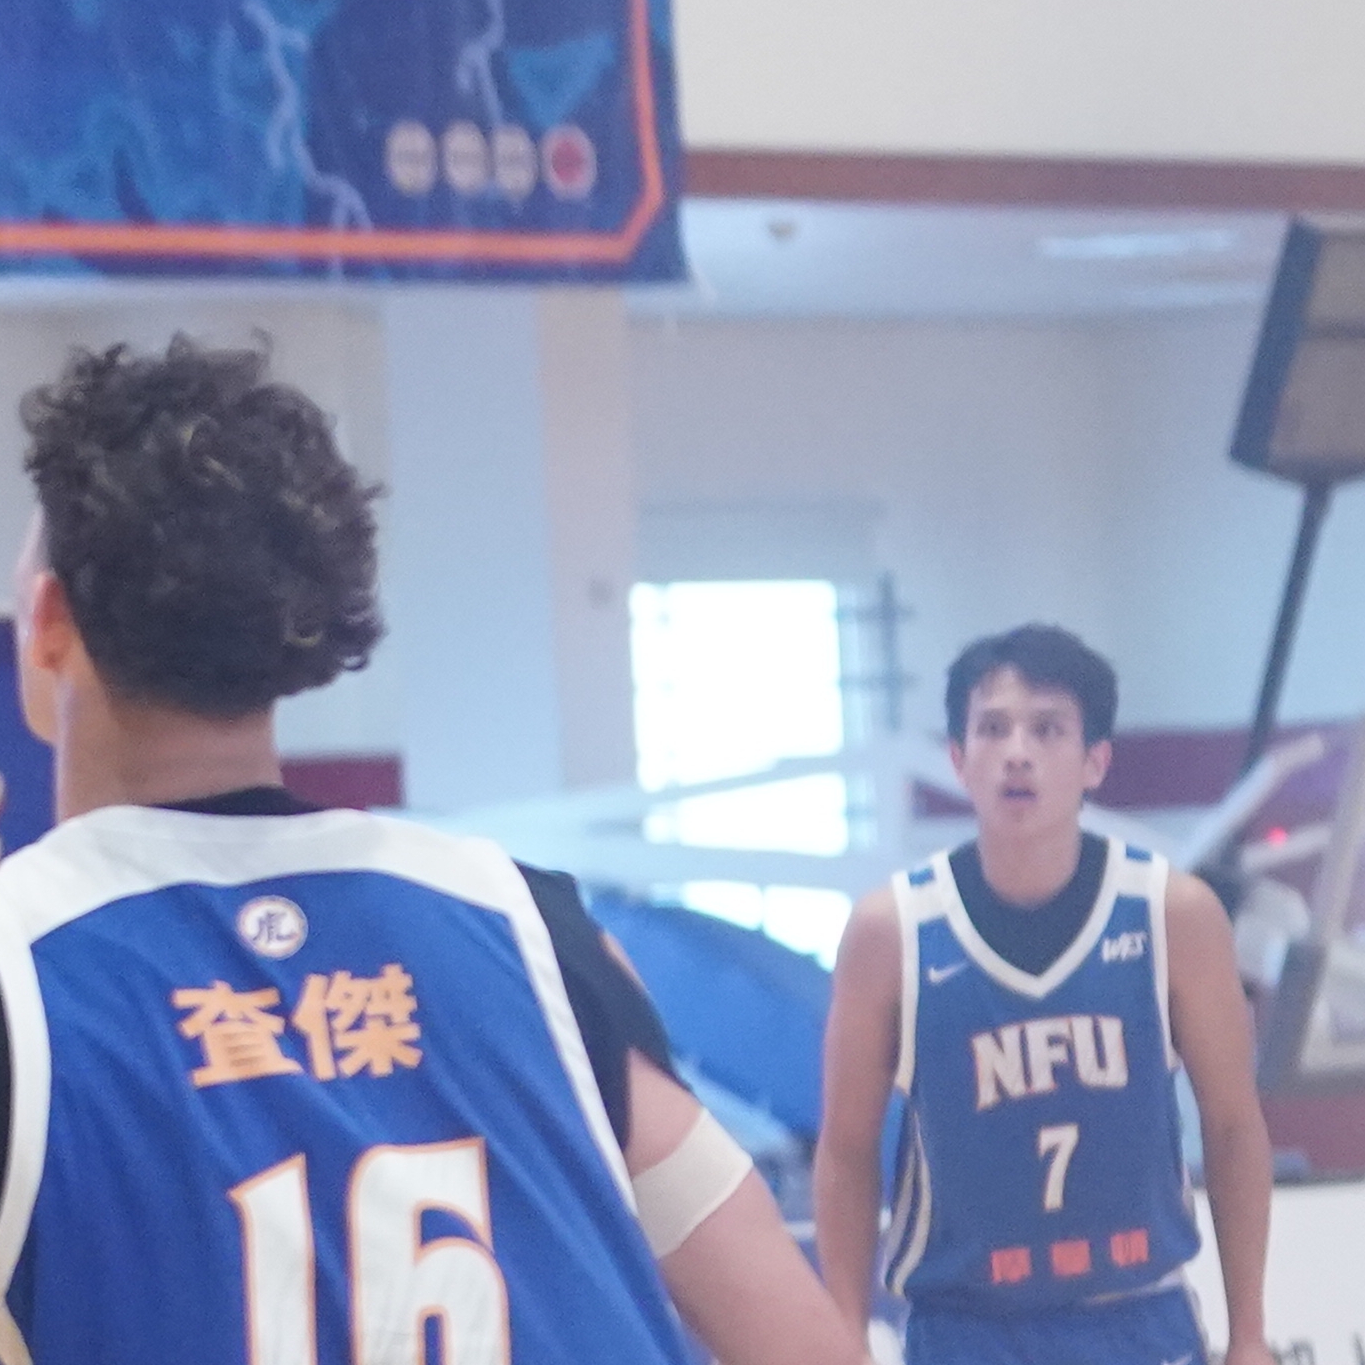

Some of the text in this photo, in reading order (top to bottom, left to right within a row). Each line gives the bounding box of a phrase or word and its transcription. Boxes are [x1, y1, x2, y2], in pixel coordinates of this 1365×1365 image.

[170, 962, 425, 1089] 查傑
[971, 1012, 1129, 1113] NFU
[1037, 1122, 1080, 1214] 7
[227, 1135, 512, 1365] 16
